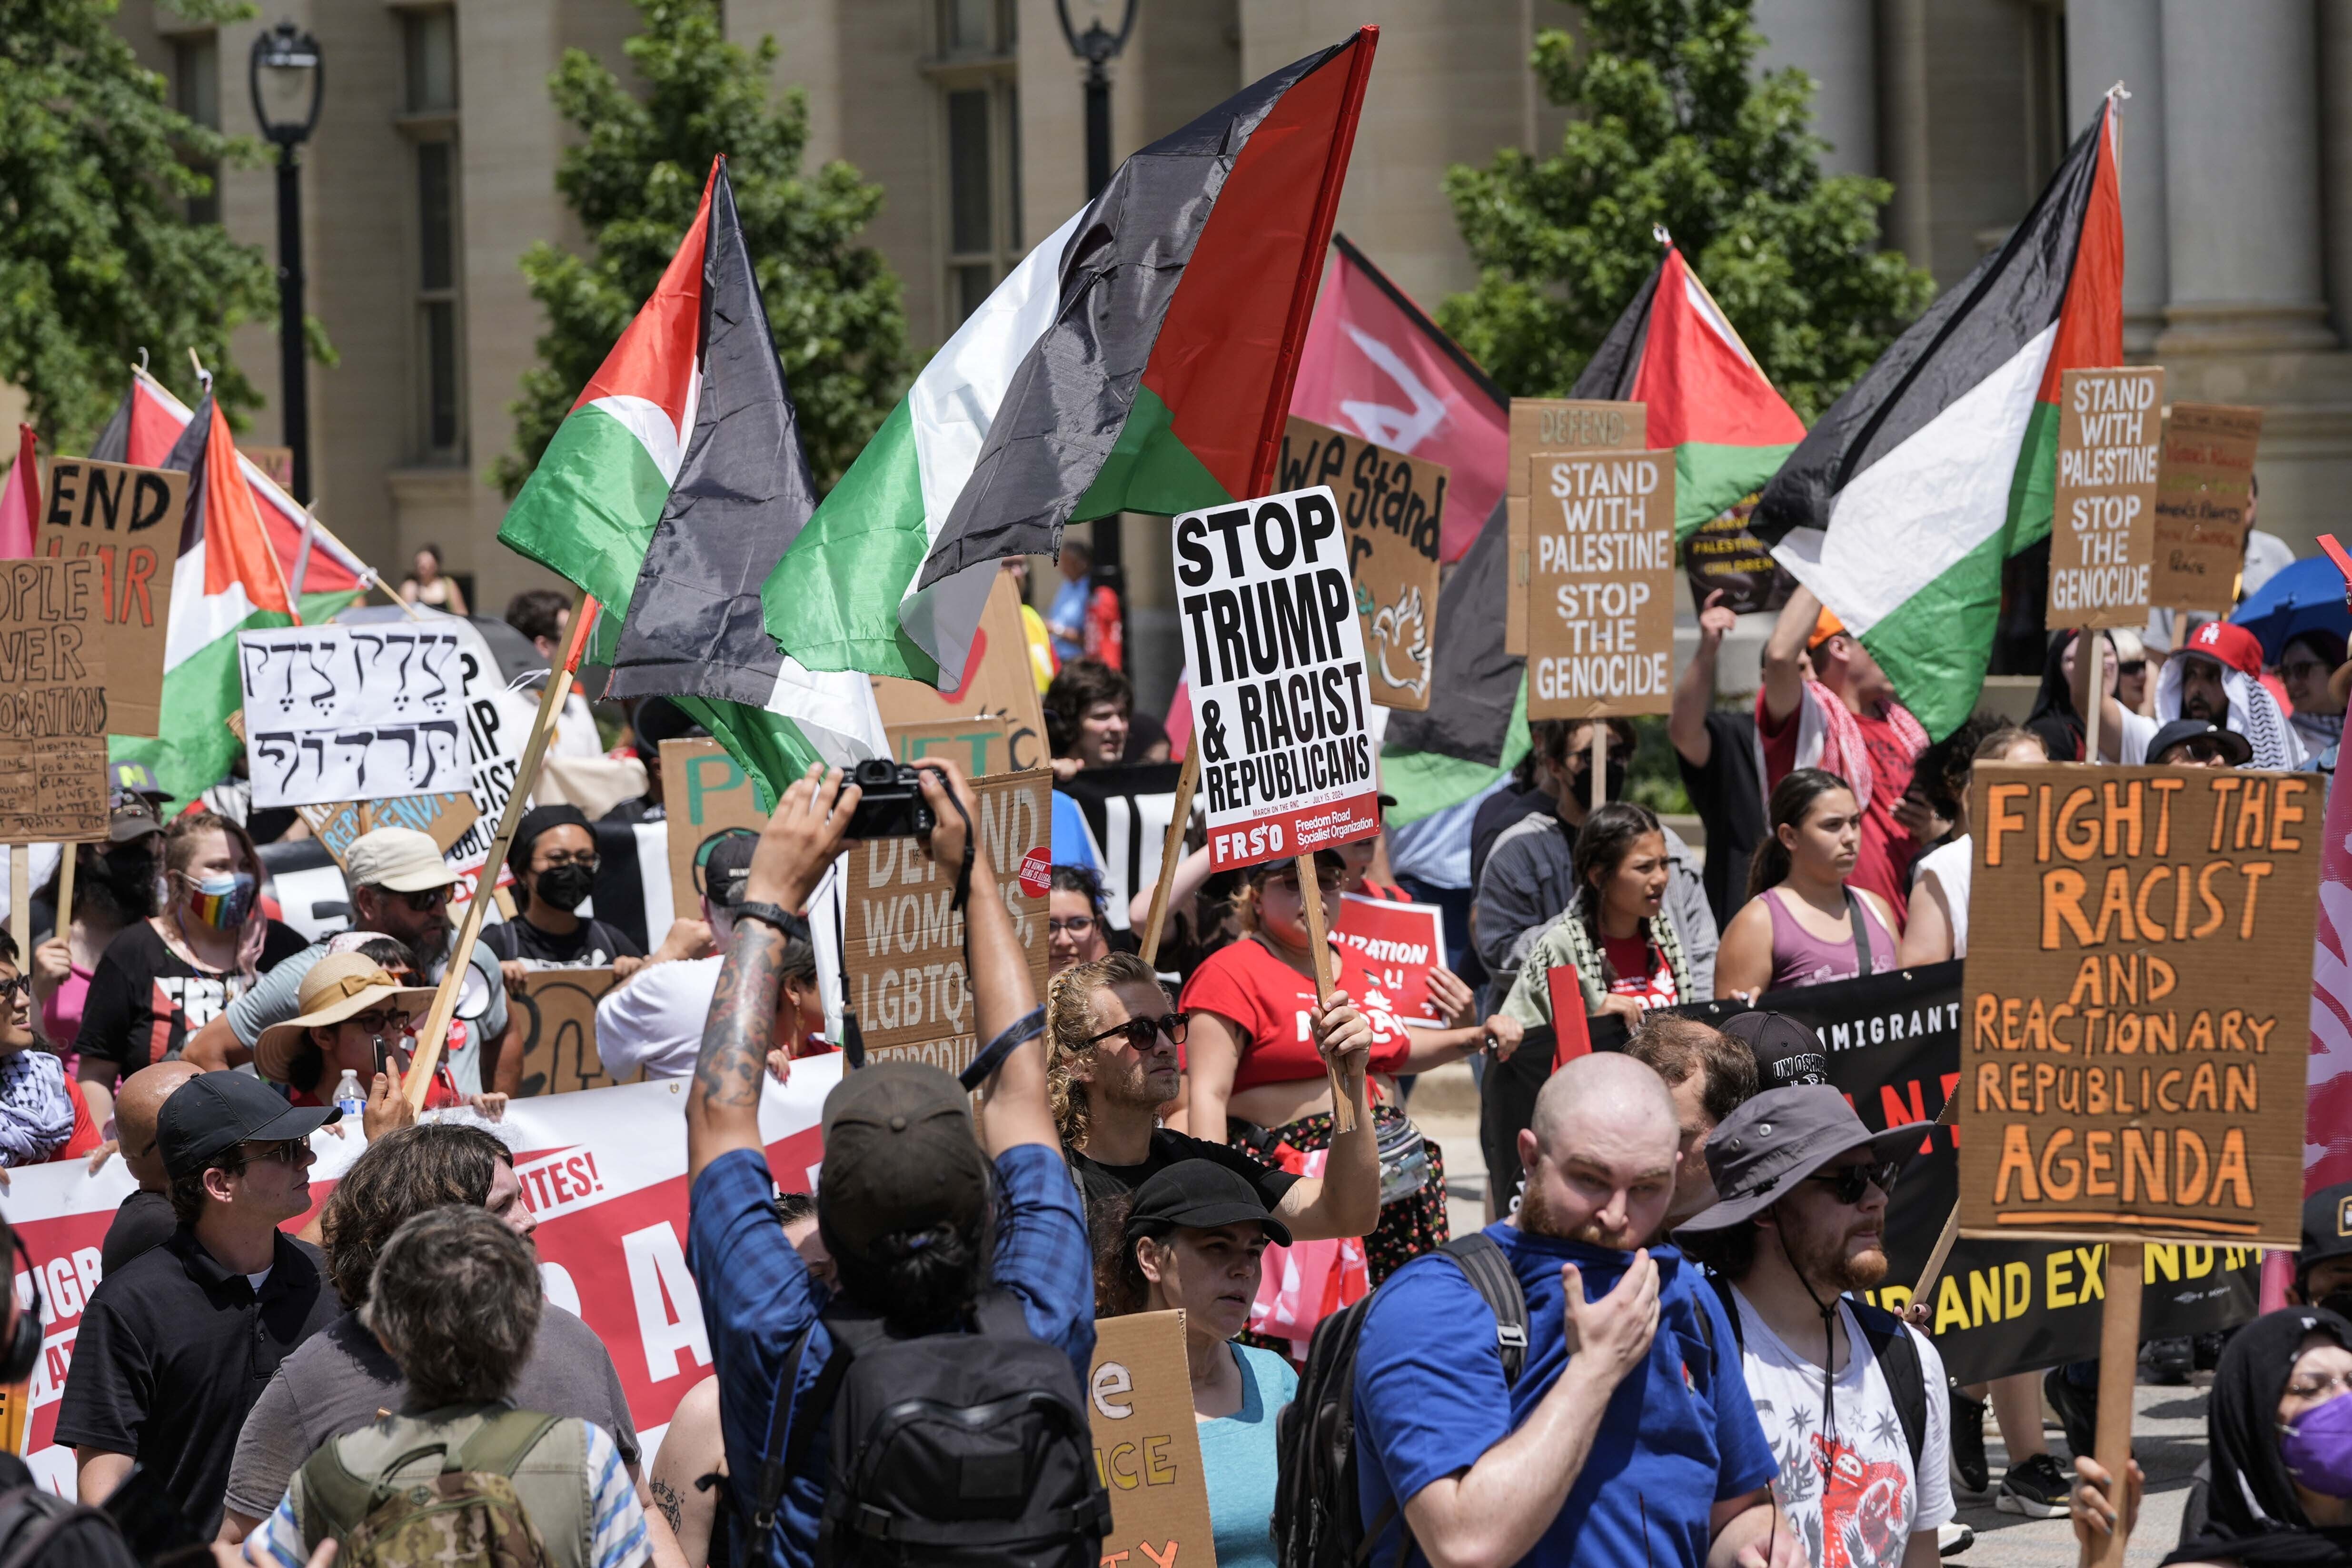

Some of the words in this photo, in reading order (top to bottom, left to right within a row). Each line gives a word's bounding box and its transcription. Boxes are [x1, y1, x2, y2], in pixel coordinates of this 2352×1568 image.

[2073, 377, 2155, 413] STAND
[1539, 408, 1624, 446] DEFEND
[2080, 410, 2143, 448] WITH
[1550, 461, 1658, 498] STAND
[2061, 446, 2158, 487] PALESTINE
[48, 464, 171, 533] END
[1562, 496, 1646, 533] WITH
[2071, 495, 2141, 532] STOP
[1177, 494, 1335, 587] STOP
[1539, 531, 1668, 573] PALESTINE
[2077, 530, 2129, 566] THE
[1557, 582, 1650, 619] STOP
[2053, 564, 2150, 611] GENOCIDE
[1184, 568, 1350, 686] TRUMP
[1567, 619, 1637, 654] THE
[1537, 653, 1668, 700] GENOCIDE
[1202, 699, 1230, 763] &
[1238, 662, 1365, 756] RACIST
[1207, 734, 1370, 814] REPUBLICANS
[1253, 807, 1270, 817] MARCH
[1280, 804, 1289, 812] THE
[1290, 800, 1300, 810] RNC
[1313, 794, 1323, 804] JULY
[1332, 790, 1344, 799] 2024
[1295, 814, 1331, 833] Freedom
[1331, 808, 1350, 823] Road
[1985, 778, 2185, 867] FIGHT
[2210, 778, 2307, 853] THE
[1297, 827, 1330, 846] Socialist
[1331, 818, 1374, 839] Organization
[1025, 860, 1032, 869] NO
[1031, 861, 1046, 872] HUMAN
[2040, 860, 2273, 951] RACIST
[2068, 953, 2177, 1006] AND
[1973, 992, 2276, 1059] REACTIONARY
[1773, 1057, 1793, 1080] UW
[1975, 1060, 2258, 1115] REPUBLICAN
[1994, 1123, 2255, 1210] AGENDA
[1935, 1261, 2031, 1336] AND
